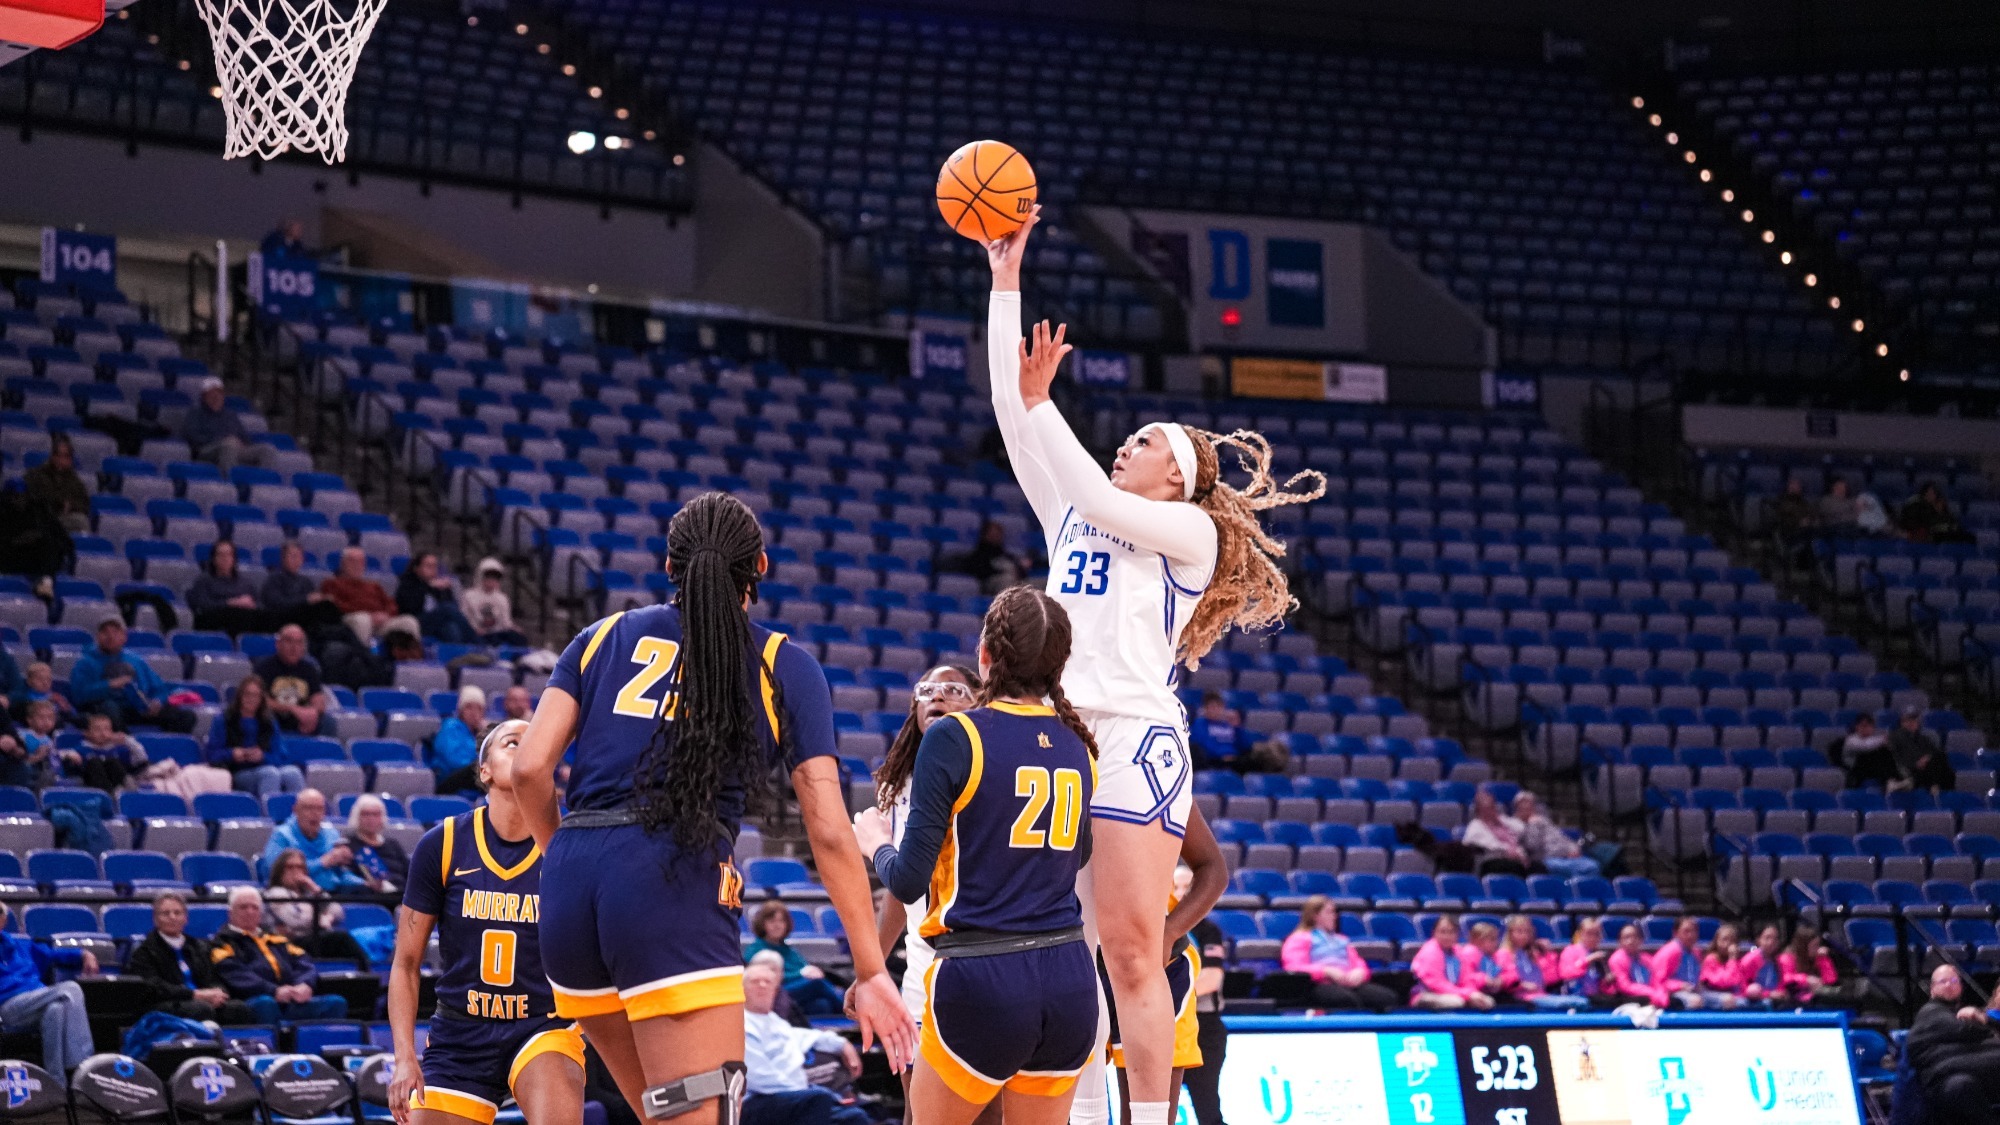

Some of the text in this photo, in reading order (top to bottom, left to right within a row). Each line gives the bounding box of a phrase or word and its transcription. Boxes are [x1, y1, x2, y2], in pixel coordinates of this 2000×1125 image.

[60, 244, 112, 273] 104
[268, 268, 315, 298] 105
[1060, 551, 1111, 596] 33
[1009, 766, 1082, 851] 20
[480, 929, 517, 987] 0
[467, 990, 528, 1019] STATE
[1471, 1045, 1538, 1091] 5:23
[1410, 1093, 1434, 1122] 12
